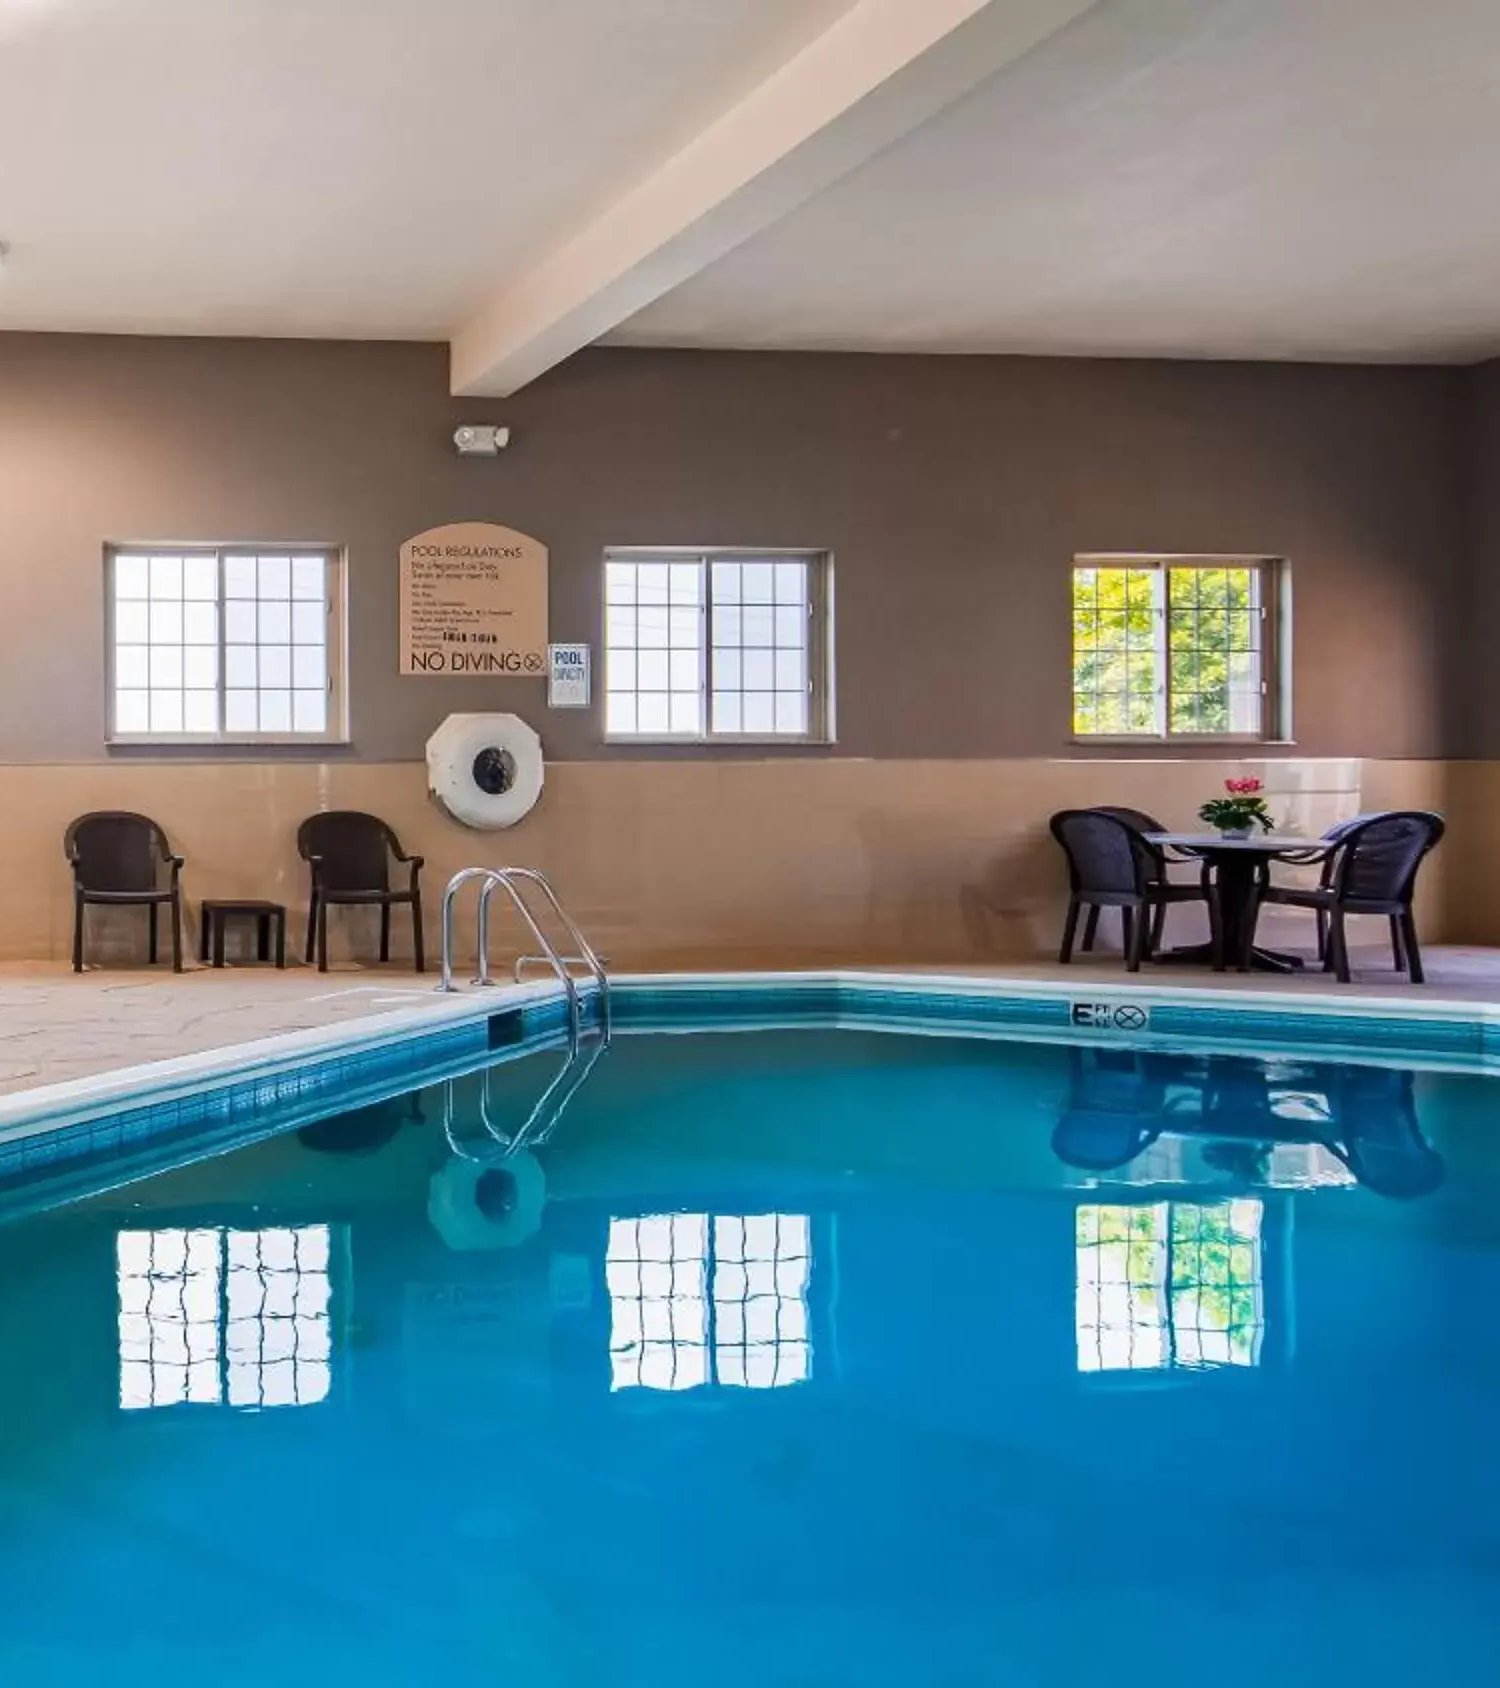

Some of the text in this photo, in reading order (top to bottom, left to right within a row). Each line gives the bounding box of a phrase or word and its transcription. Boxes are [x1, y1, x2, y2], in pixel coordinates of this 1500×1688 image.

[411, 545, 523, 558] POOL REGULATIONS
[411, 651, 521, 671] NO DIVING
[555, 651, 584, 665] POOL
